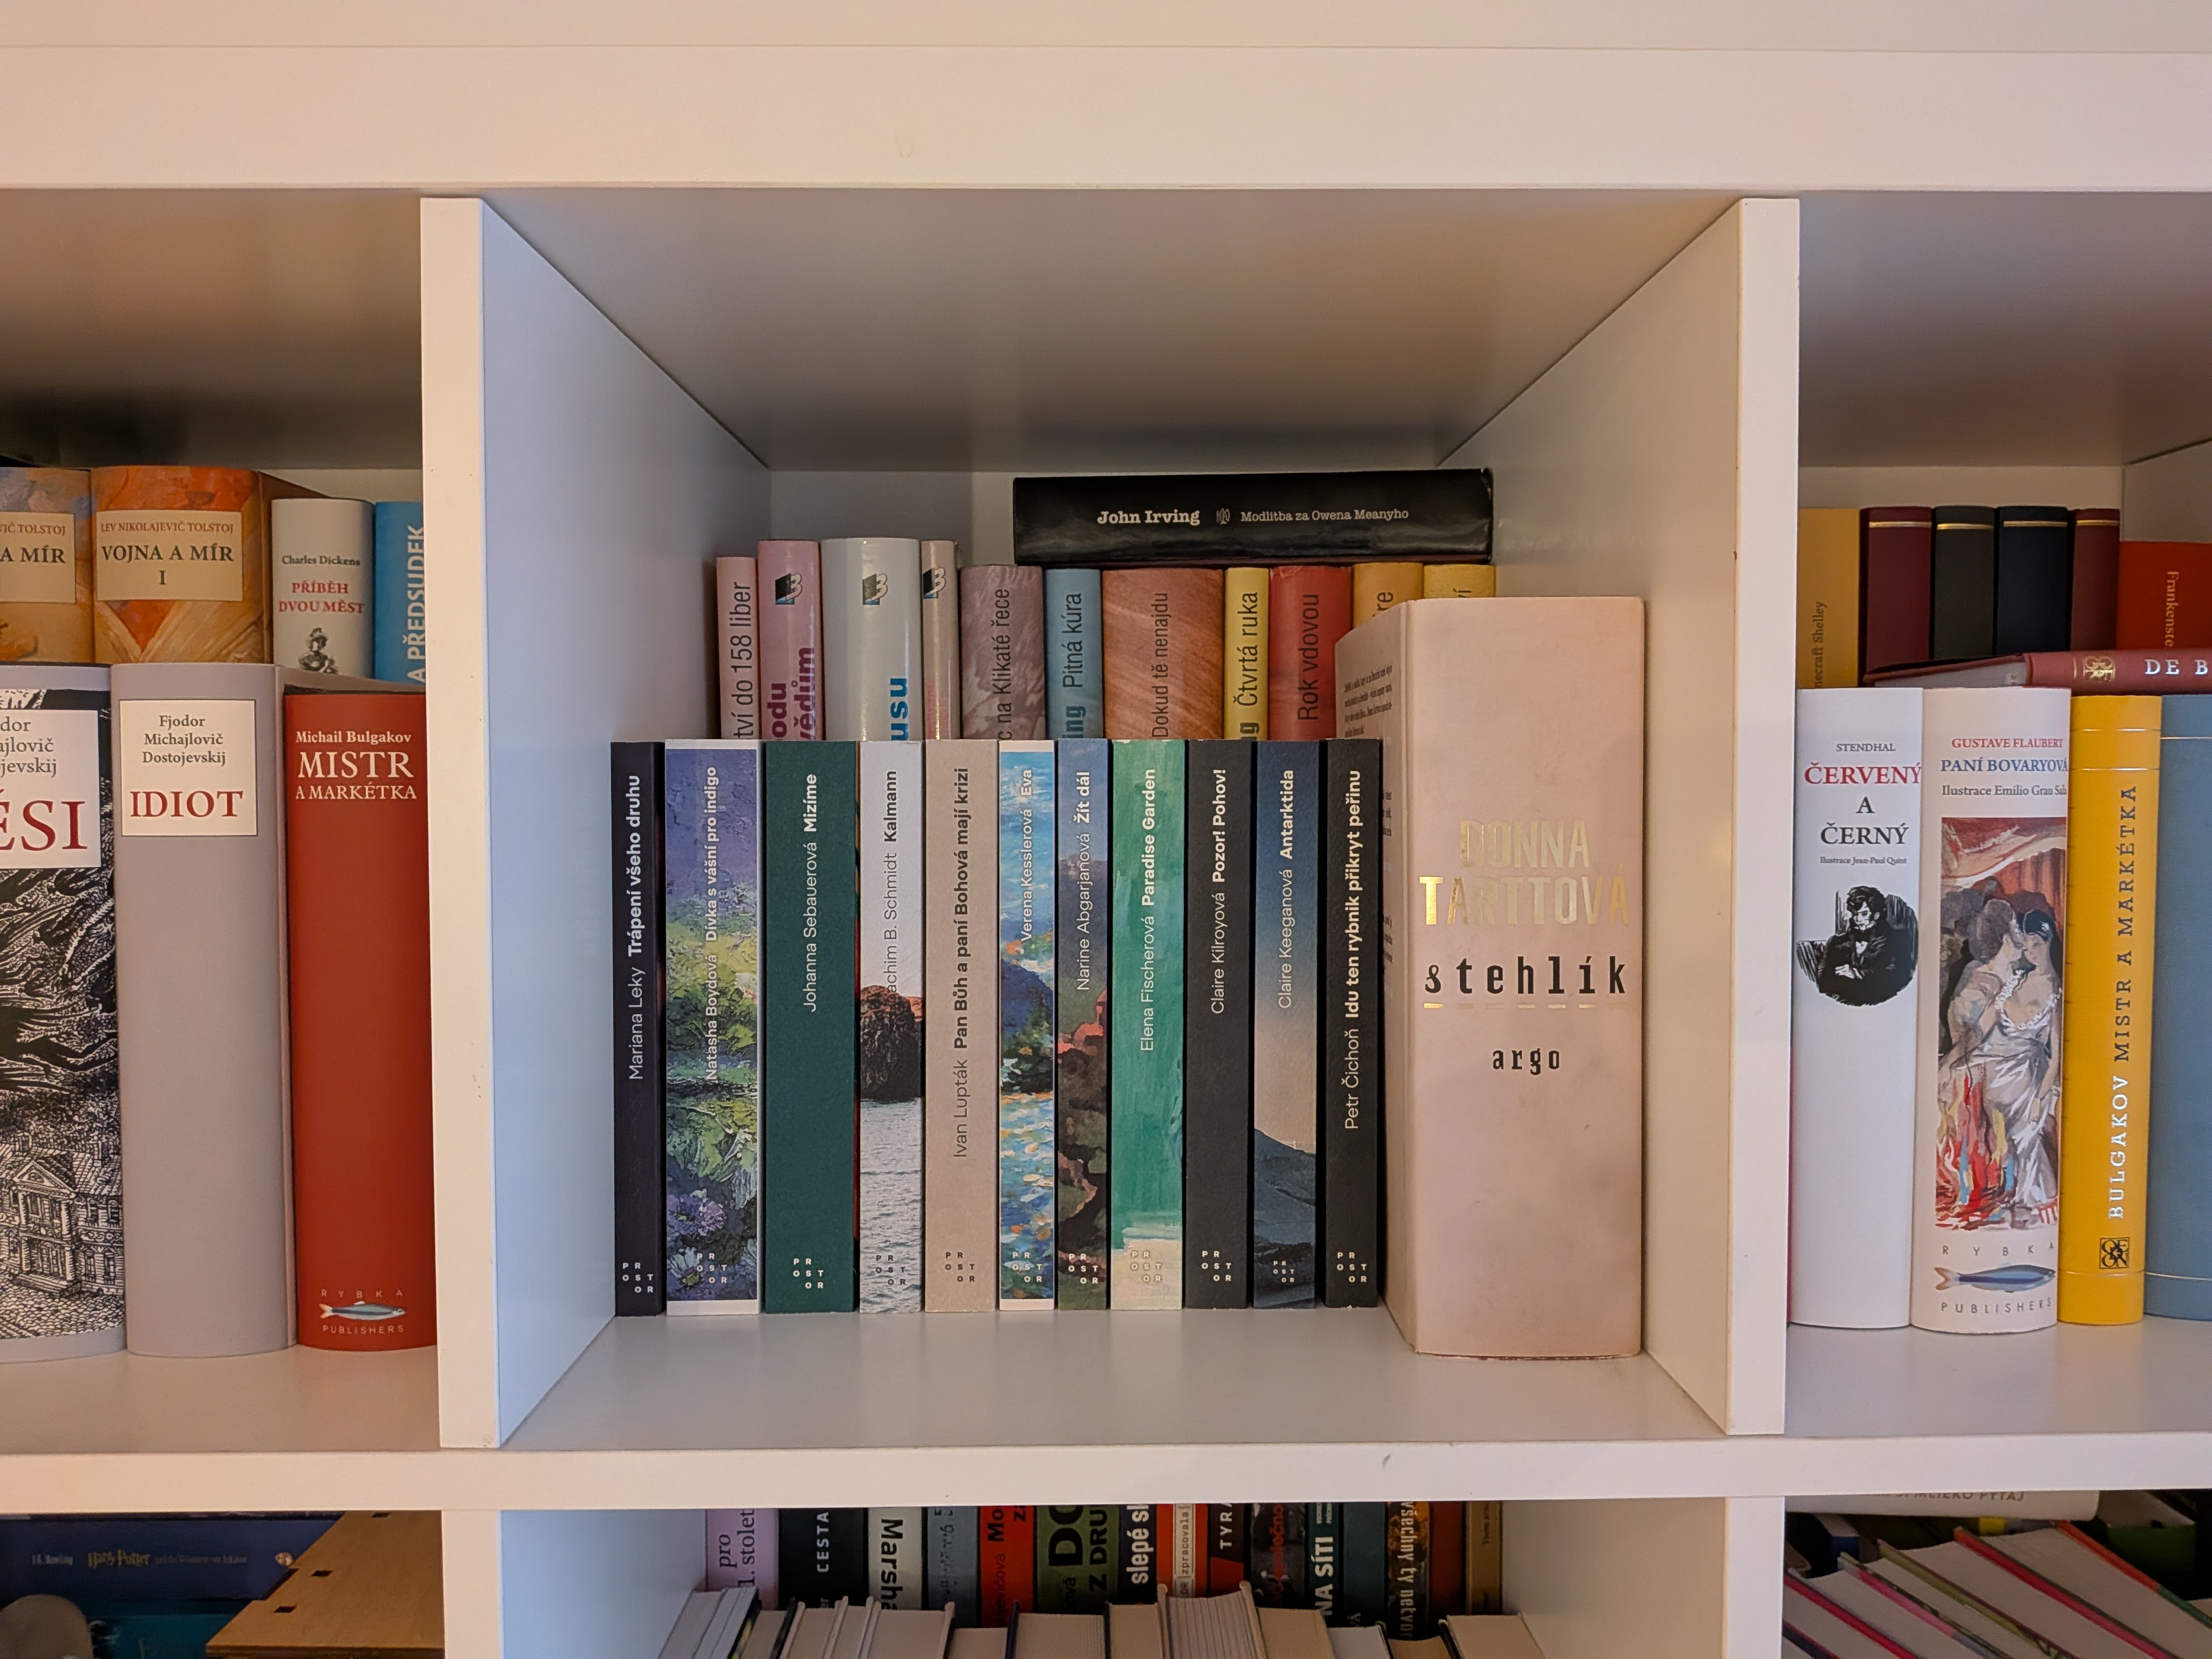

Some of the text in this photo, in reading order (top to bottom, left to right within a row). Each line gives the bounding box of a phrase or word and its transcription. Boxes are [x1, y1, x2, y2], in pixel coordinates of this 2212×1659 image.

[101, 521, 233, 534] LEV NIKOLAJEVIČ TOLSTOJ
[1097, 509, 1201, 526] John Irving
[1241, 508, 1409, 522] Modlitba za Owena Meanyho
[18, 524, 65, 535] TOLSTOJ
[0, 545, 65, 563] A MÍR
[102, 543, 234, 562] VOJNA A MÍR
[282, 555, 361, 566] Charles Dickens
[159, 570, 166, 585] I
[291, 580, 348, 594] PŘÍBĚH
[279, 599, 365, 614] DVOU MĚST
[402, 525, 425, 682] A PŘEDSUDEK
[990, 588, 1011, 627] řece
[1238, 592, 1258, 636] ruka
[1812, 601, 1827, 643] Shelley
[729, 581, 753, 706] do 158 liber
[1060, 593, 1083, 687] Pitná kúra
[991, 635, 1011, 695] Klikaté
[1151, 593, 1171, 738] Dokud tě nenajdu
[1297, 594, 1319, 720] Rok vdovou
[2145, 659, 2180, 675] DE
[1233, 645, 1258, 706] Čtvrtá
[159, 715, 206, 729] Fjodor
[998, 703, 1011, 724] na
[144, 732, 224, 748] Michajlovič
[296, 731, 412, 747] Michail Bulgakov
[1836, 743, 1896, 752] STENDHAL
[1952, 737, 2063, 749] GUSTAVE FLAUBERT
[142, 750, 226, 767] Dostojevskij
[298, 751, 414, 779] MISTR
[1940, 757, 2068, 773] PANÍ BOVARYOVÁ
[1804, 761, 1922, 785] ČERVENÝ
[296, 781, 418, 801] A MARKÉTKA
[1942, 785, 1992, 796] Ilustrace
[1995, 784, 2028, 796] Emilio
[130, 791, 243, 818] IDIOT
[884, 770, 898, 843] Kalmann
[1856, 797, 1875, 814] A
[1460, 819, 1590, 868] DONNA
[1820, 822, 1910, 846] ČERNÝ
[1019, 769, 1033, 941] Verena Kesslerová Eva
[1820, 857, 1907, 867] Ilustrace Jean-Paul Quint
[802, 774, 818, 1013] Johanna Sebauerová Mizíme
[884, 852, 898, 922] Schmidt
[1073, 772, 1094, 990] Narine Abgarjanová Žít dál
[1211, 769, 1229, 1014] Claire Kilroyová Pozor! Pohov!
[1278, 770, 1296, 1009] Claire Keeganová Antarktida
[1419, 864, 1629, 925] TARTTOVÁ
[704, 766, 722, 1080] Natasha Boydová Dívka s vášní pro indigo
[1139, 769, 1156, 1051] Elena Fischerová Paradise Garden
[625, 775, 646, 1079] Mariana Leky Trápení všeho druhu
[884, 926, 898, 941] B.
[951, 768, 972, 1158] Ivan Lupták Pan Bůh a paní Bohová mají krizi
[1341, 770, 1364, 1129] Petr Čichoň Idu ten rybnik přikryt peřinu
[1425, 956, 1625, 994] stehlík
[2109, 786, 2137, 1219] BULGAKOV MISTR A MARKÉTKA
[1493, 1048, 1560, 1076] argo
[1942, 1242, 2054, 1257] RYBKA
[321, 1289, 403, 1298] RYBKA
[1941, 1297, 2052, 1314] PUBLISHERS
[322, 1324, 404, 1334] PUBLISHERS
[719, 1533, 737, 1568] pro
[817, 1512, 830, 1572] CESTA
[1180, 1511, 1191, 1575] zpracovala
[117, 1550, 150, 1566] Potter
[1126, 1529, 1154, 1584] slepé
[1311, 1536, 1334, 1577] SÍTI
[1089, 1574, 1106, 1591] Z
[1399, 1567, 1416, 1583] ty
[1315, 1584, 1333, 1616] NA
